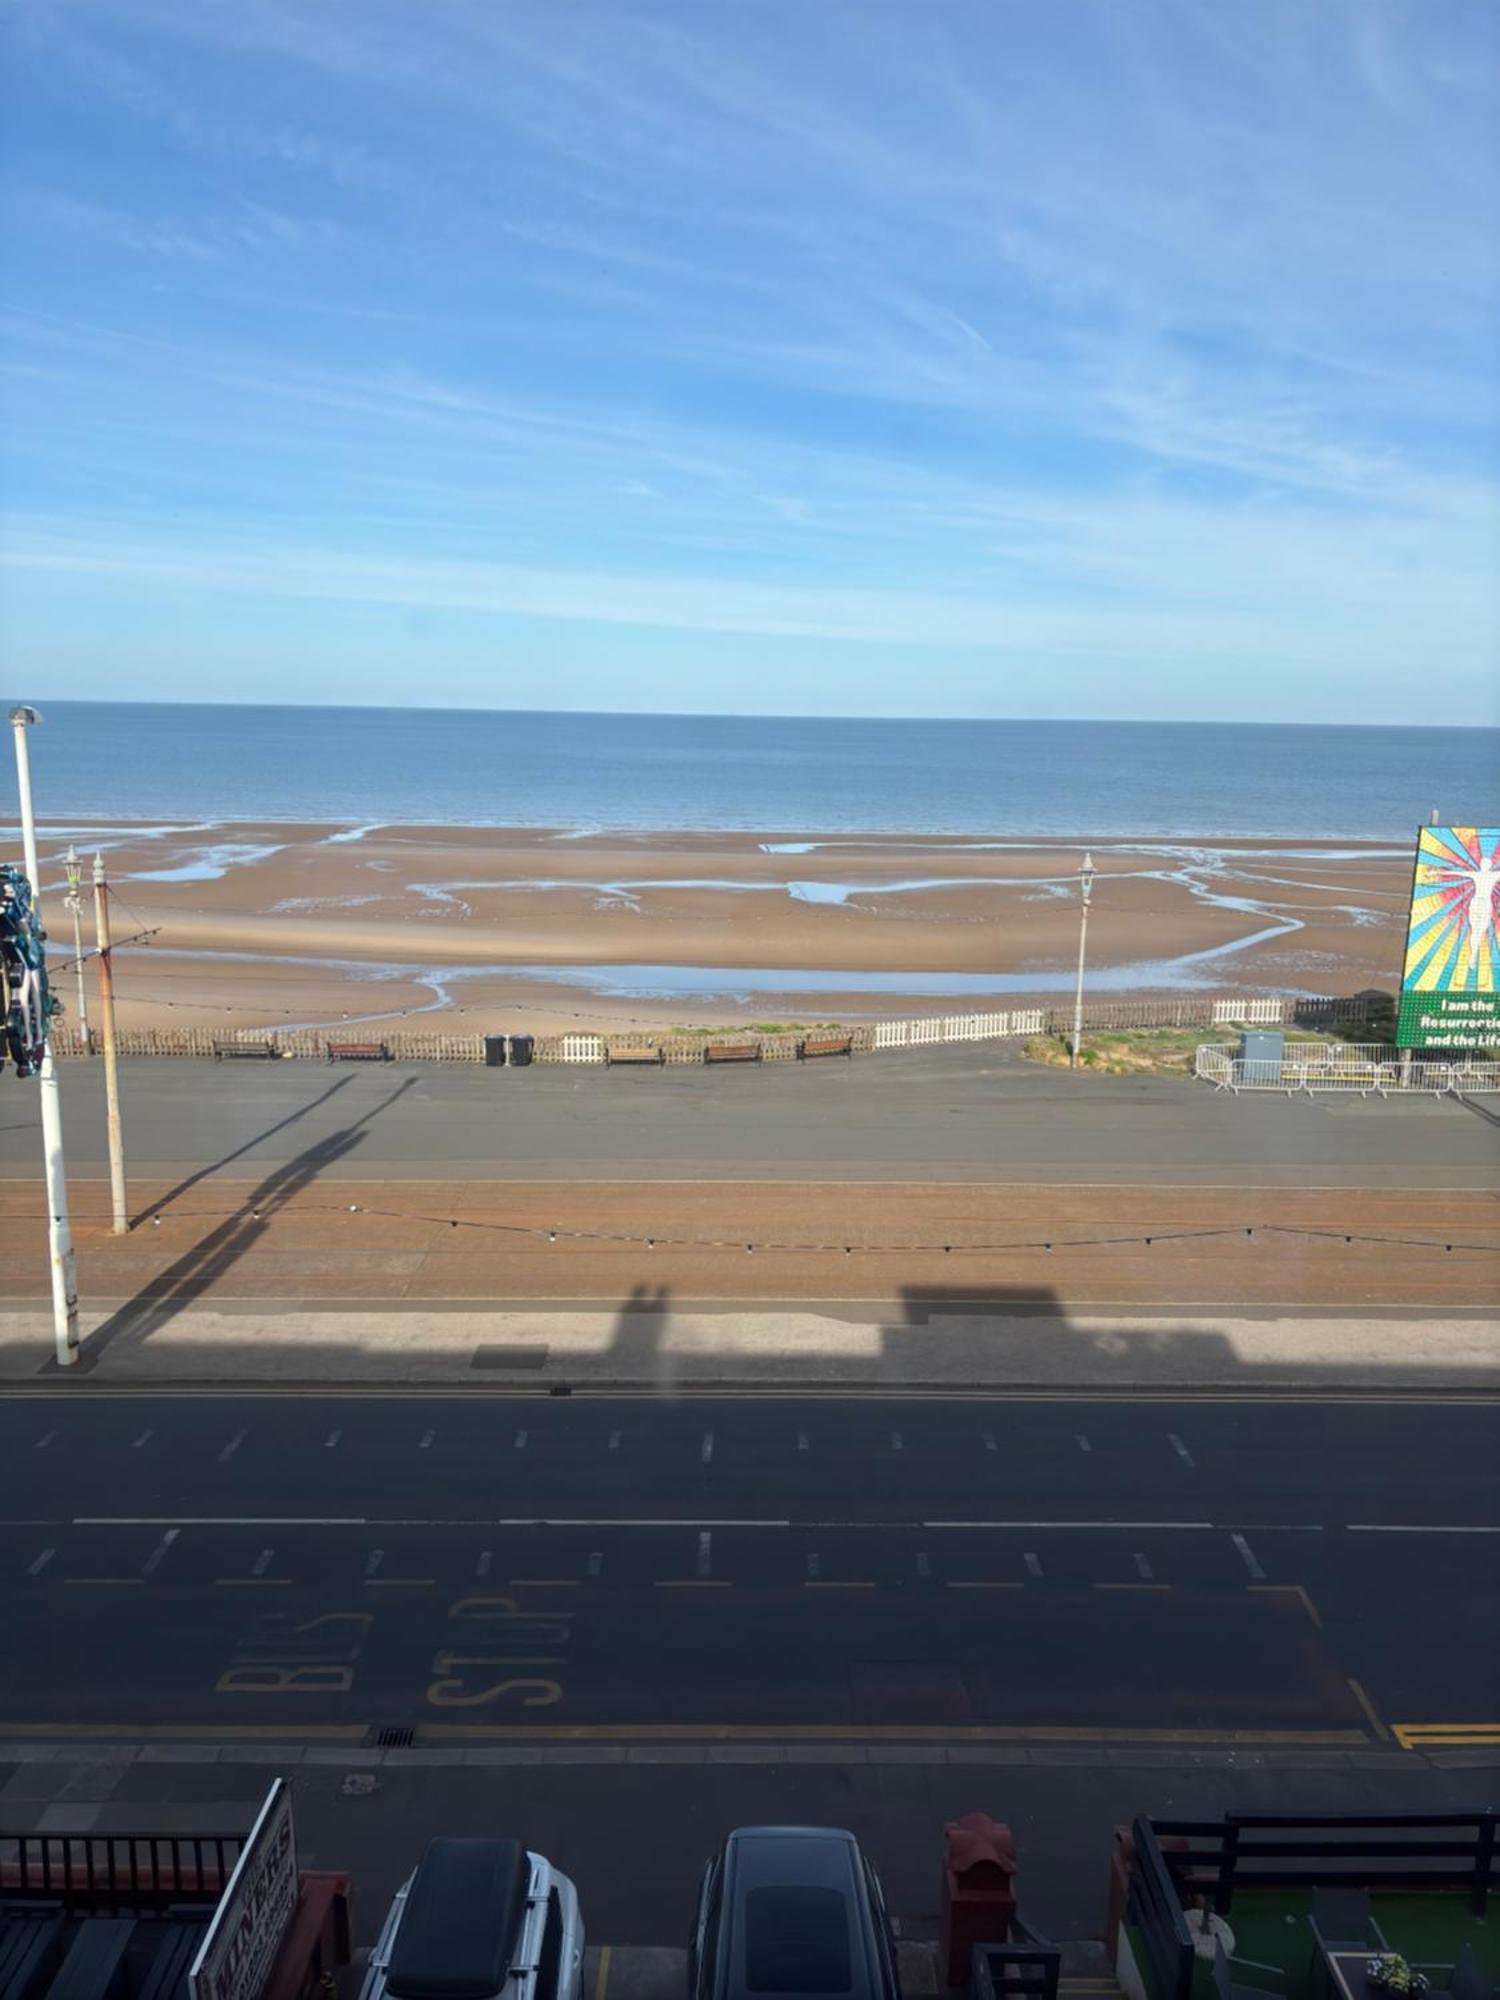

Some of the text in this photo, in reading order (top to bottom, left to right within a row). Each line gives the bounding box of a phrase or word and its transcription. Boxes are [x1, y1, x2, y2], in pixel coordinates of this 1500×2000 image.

[1448, 1002, 1469, 1011] am
[1471, 1000, 1495, 1011] the
[1425, 1035, 1451, 1045] and
[1453, 1035, 1476, 1045] the
[213, 1611, 374, 1692] BUS
[426, 1597, 575, 1706] STOP
